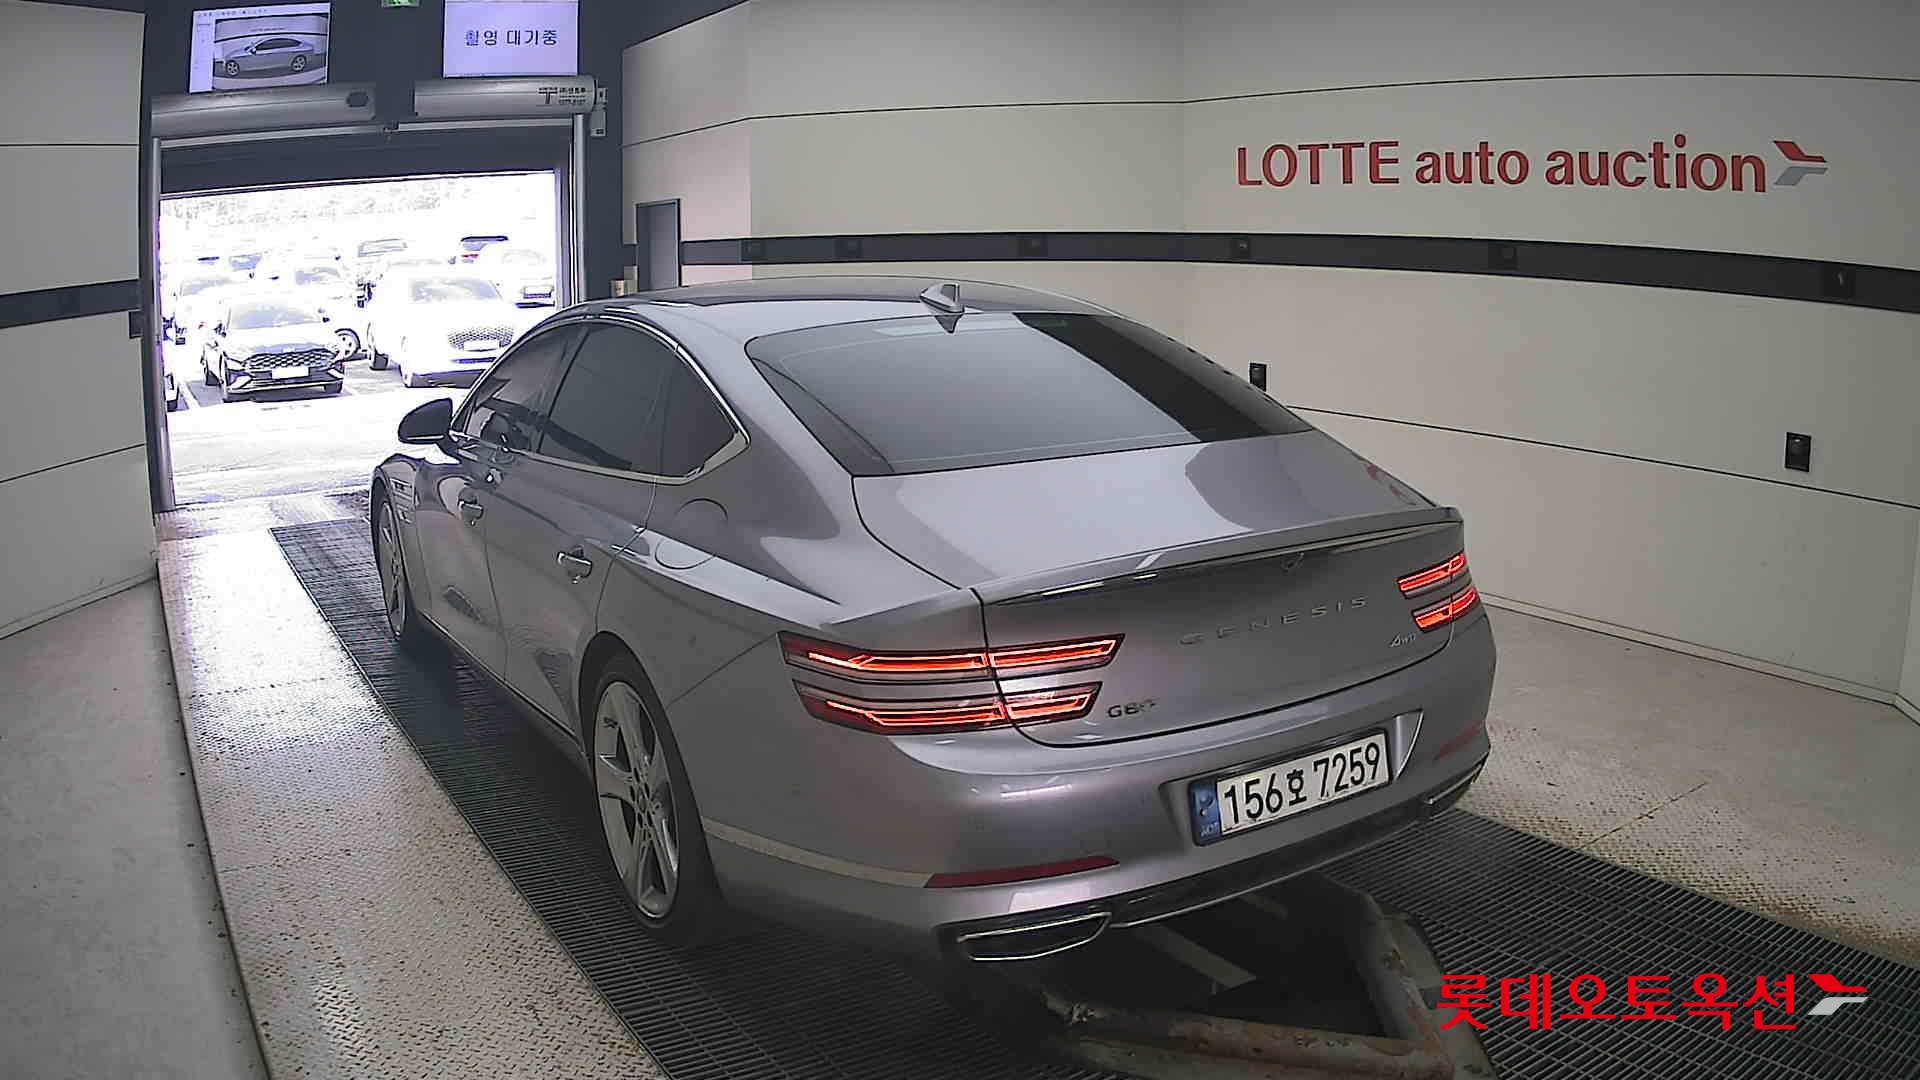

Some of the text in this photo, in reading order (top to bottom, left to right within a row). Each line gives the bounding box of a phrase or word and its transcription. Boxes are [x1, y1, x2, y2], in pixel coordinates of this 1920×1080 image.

[505, 29, 558, 46] 대기중
[1237, 133, 1768, 192] LOTTE auto auction
[1180, 595, 1368, 645] GENESIS
[1224, 741, 1380, 825] 156호 7259
